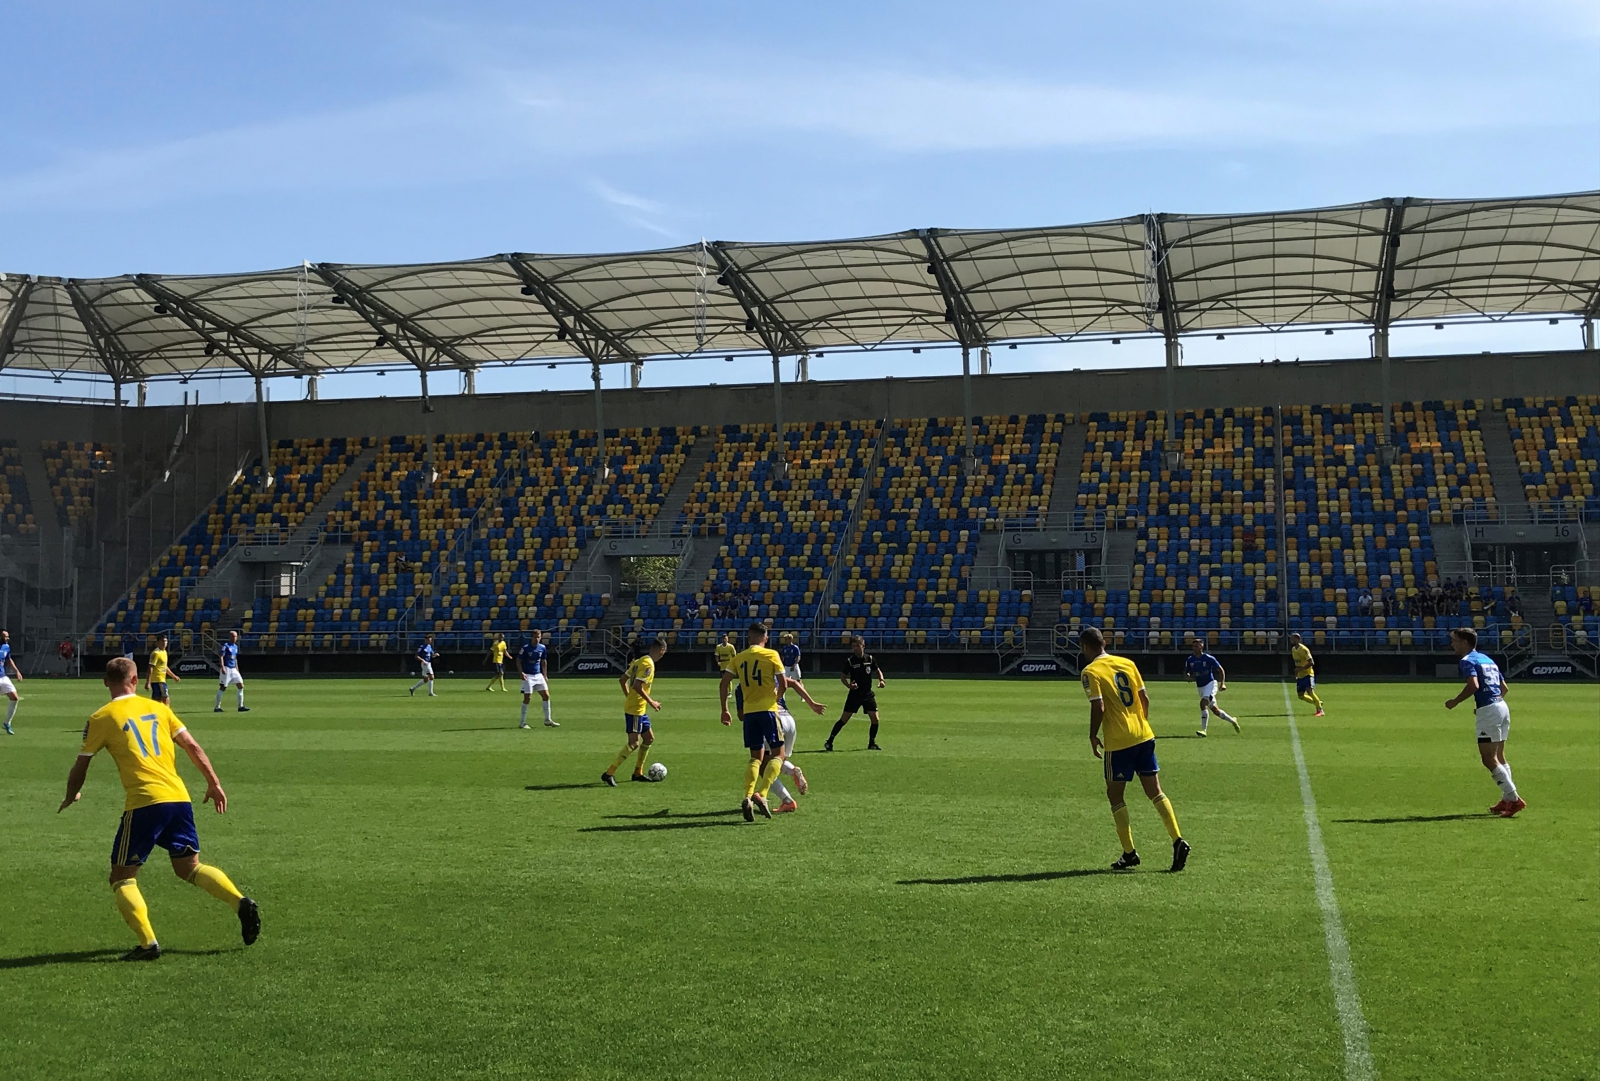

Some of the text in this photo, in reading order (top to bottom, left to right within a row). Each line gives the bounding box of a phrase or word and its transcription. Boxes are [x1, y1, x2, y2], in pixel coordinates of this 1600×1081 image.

[1474, 526, 1485, 538] H
[1553, 525, 1570, 538] 16
[1012, 533, 1022, 545] G
[1083, 532, 1098, 544] 15
[608, 540, 618, 551] G
[671, 539, 684, 550] 14
[243, 546, 252, 557] G
[577, 662, 609, 671] GDYNIA
[1021, 664, 1057, 672] GDYNIA
[1532, 666, 1572, 675] GDYNIA
[739, 659, 762, 688] 14
[1114, 671, 1134, 708] 8
[122, 713, 161, 759] 17
